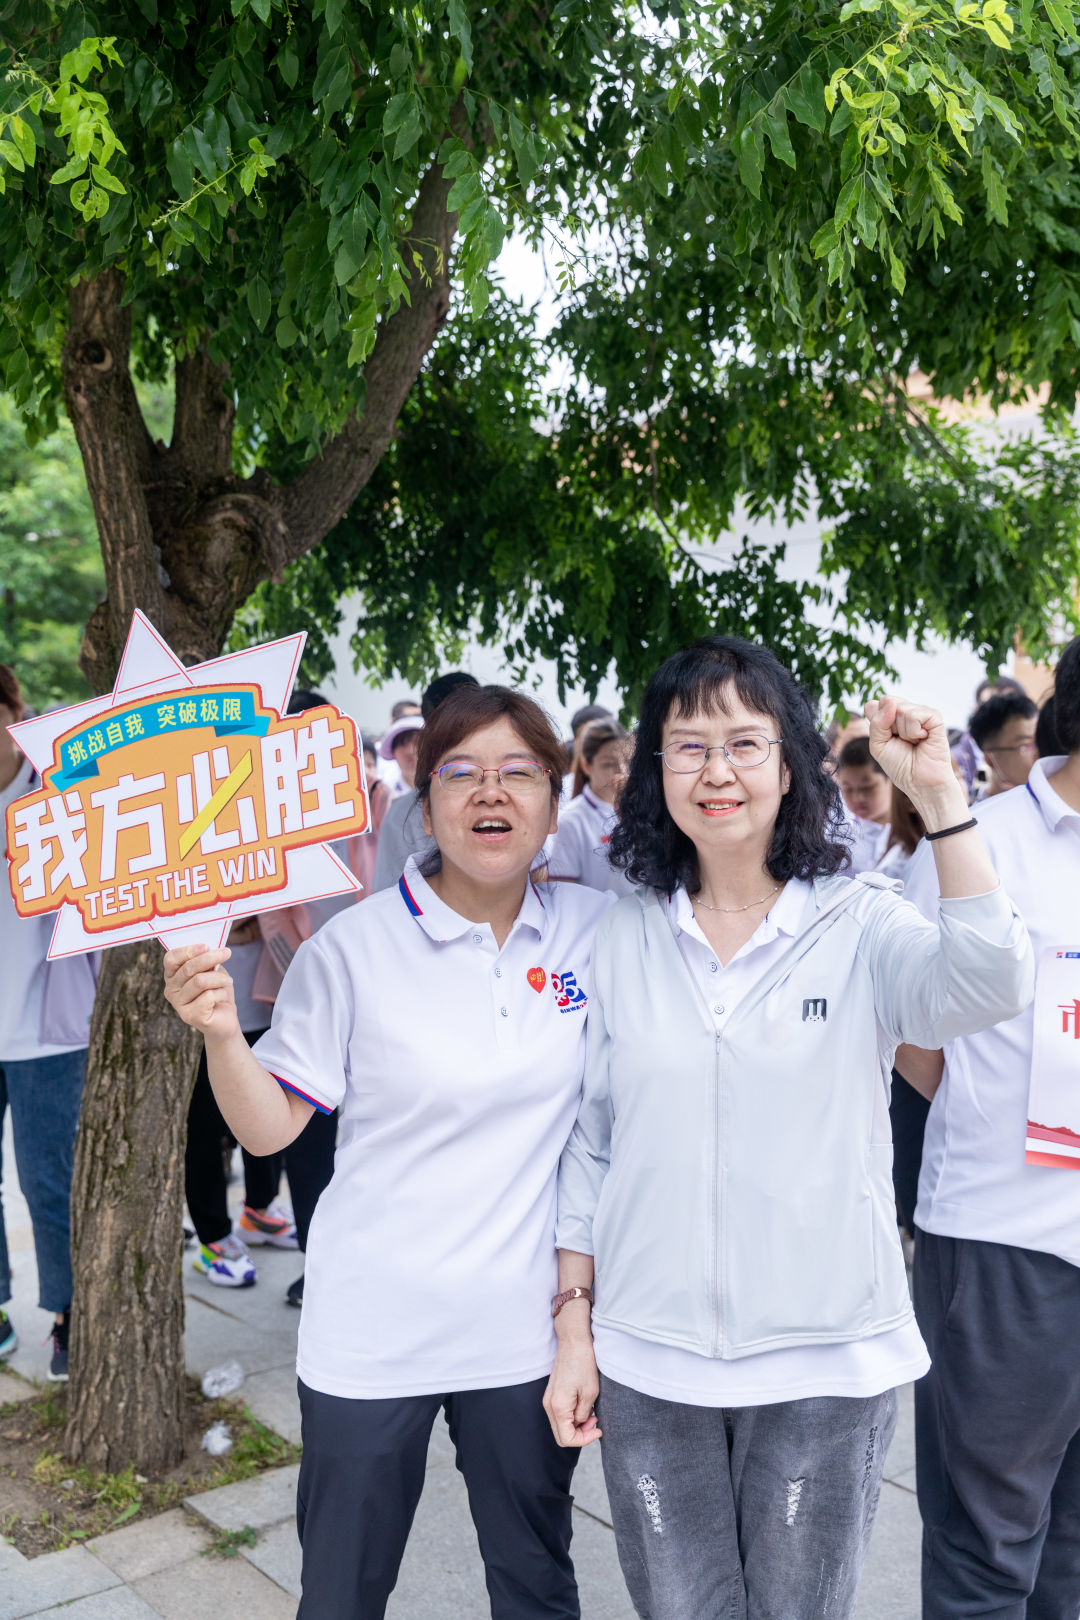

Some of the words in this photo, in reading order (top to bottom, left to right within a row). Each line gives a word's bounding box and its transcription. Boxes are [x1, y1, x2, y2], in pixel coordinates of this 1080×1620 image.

[67, 713, 145, 767] 挑战自我
[156, 697, 242, 729] 突破极限
[13, 717, 355, 903] 我方必胜
[84, 878, 149, 920] TEST
[156, 864, 210, 902] THE
[217, 847, 277, 887] WIN
